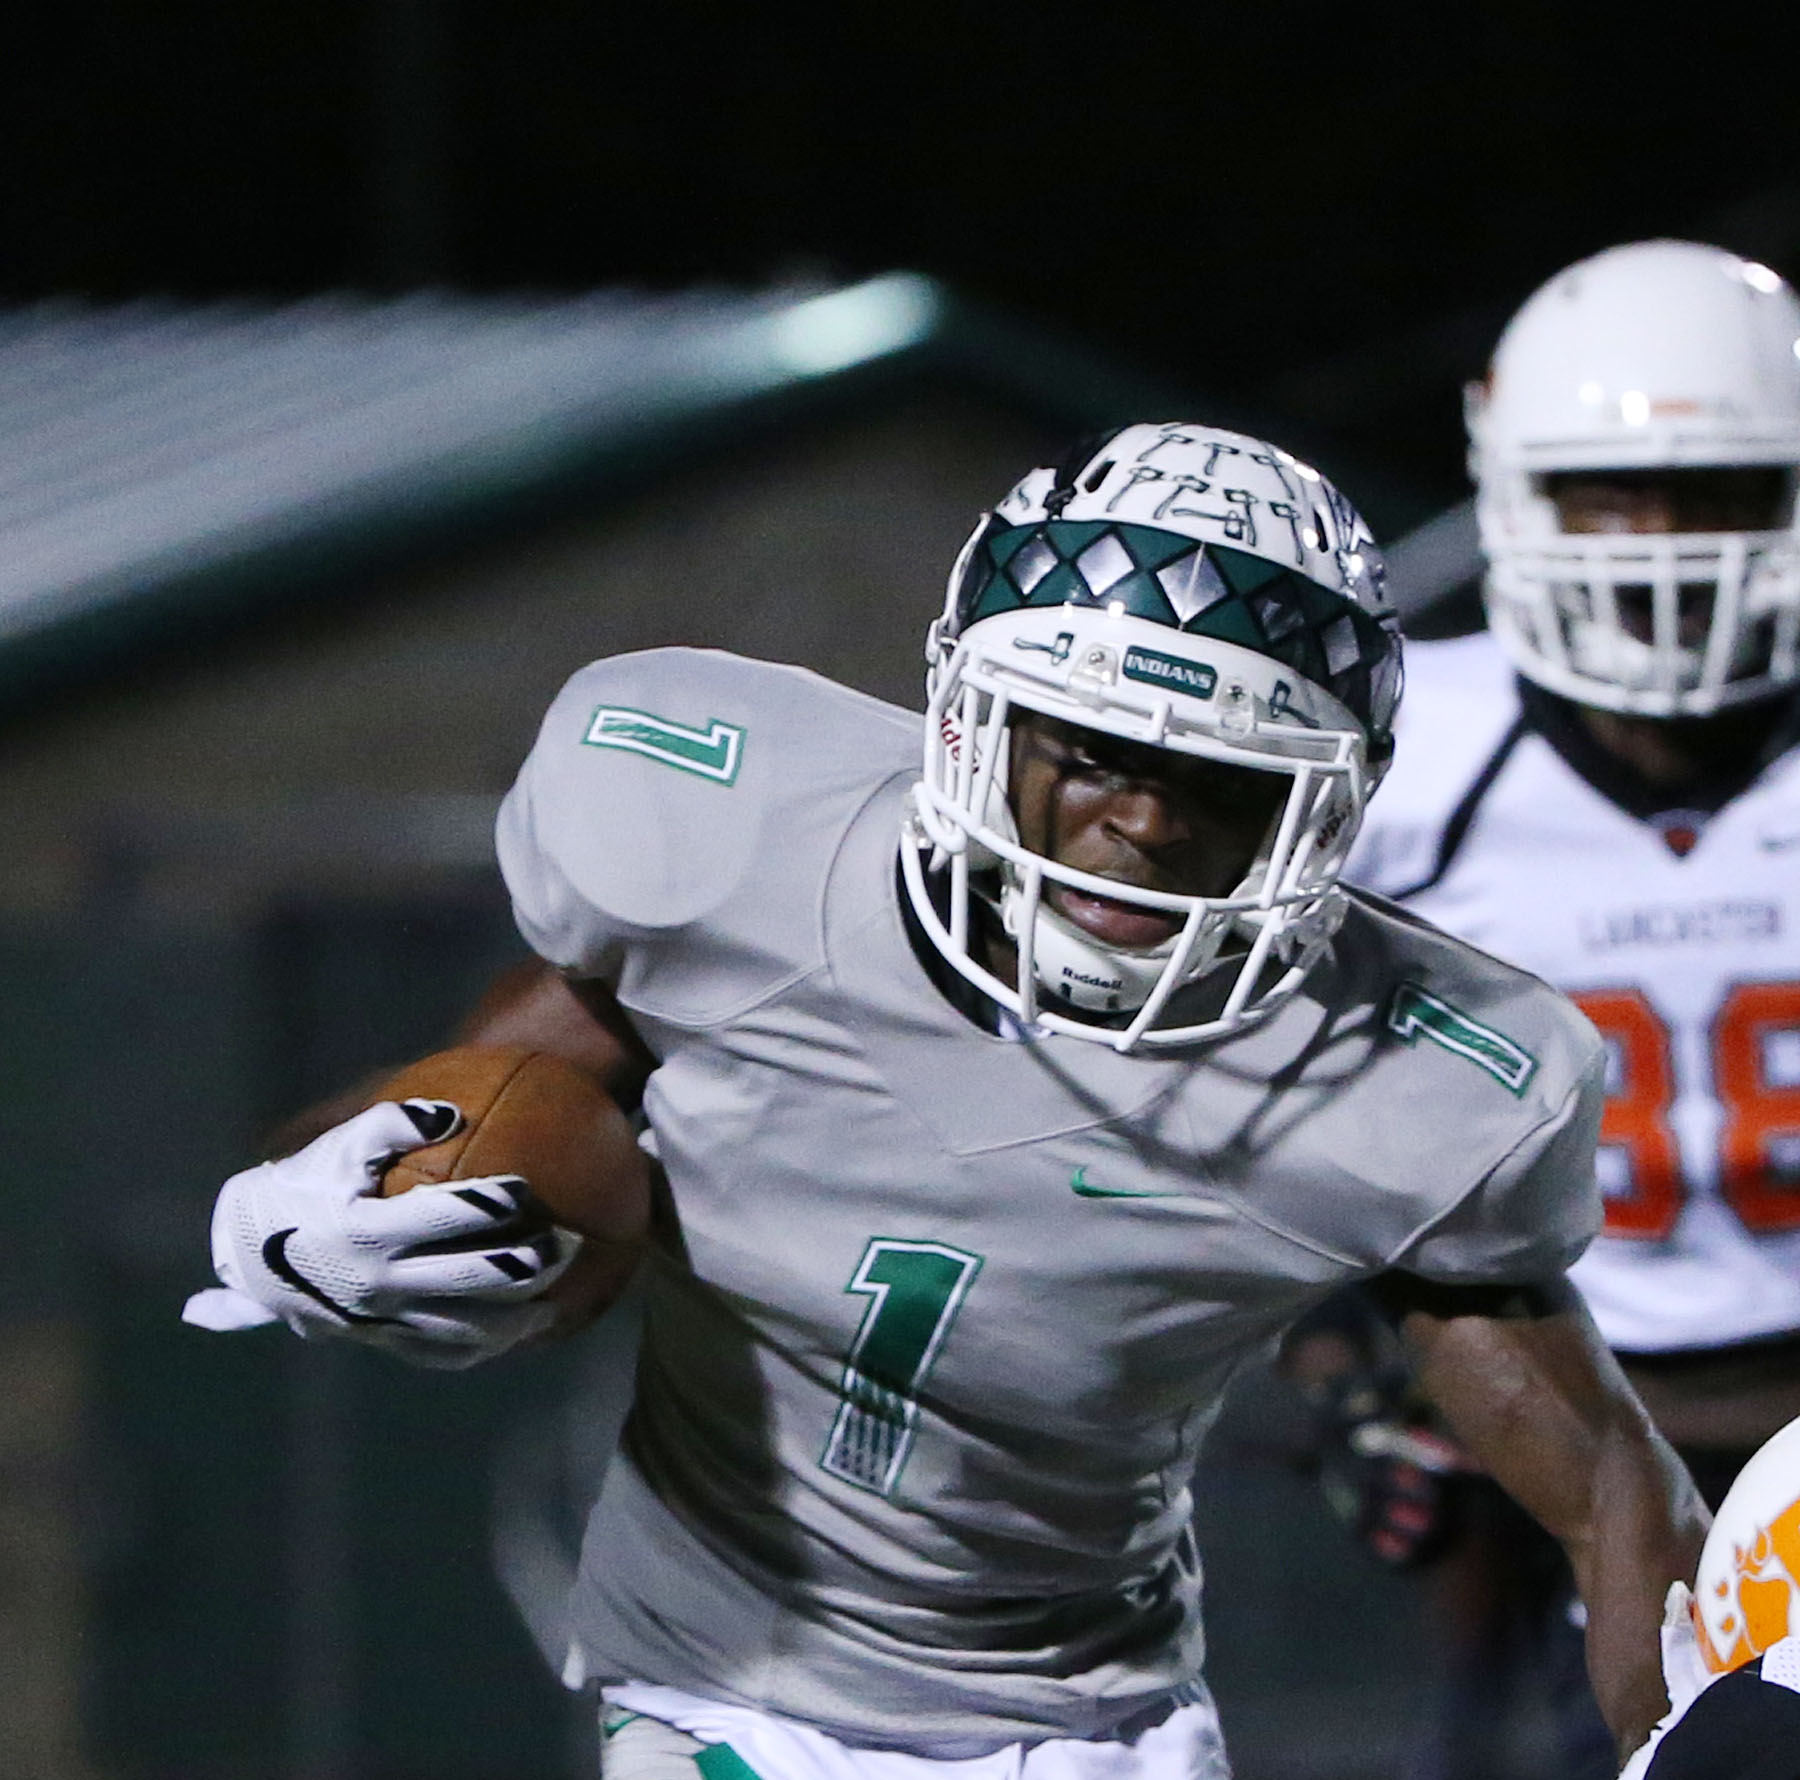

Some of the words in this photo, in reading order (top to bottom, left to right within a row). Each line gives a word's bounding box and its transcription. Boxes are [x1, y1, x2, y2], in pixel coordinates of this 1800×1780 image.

[1126, 653, 1213, 690] INDIANS
[580, 704, 748, 788] 1
[1063, 967, 1122, 990] Riddell
[1389, 979, 1540, 1098] 1
[820, 1236, 985, 1496] 1
